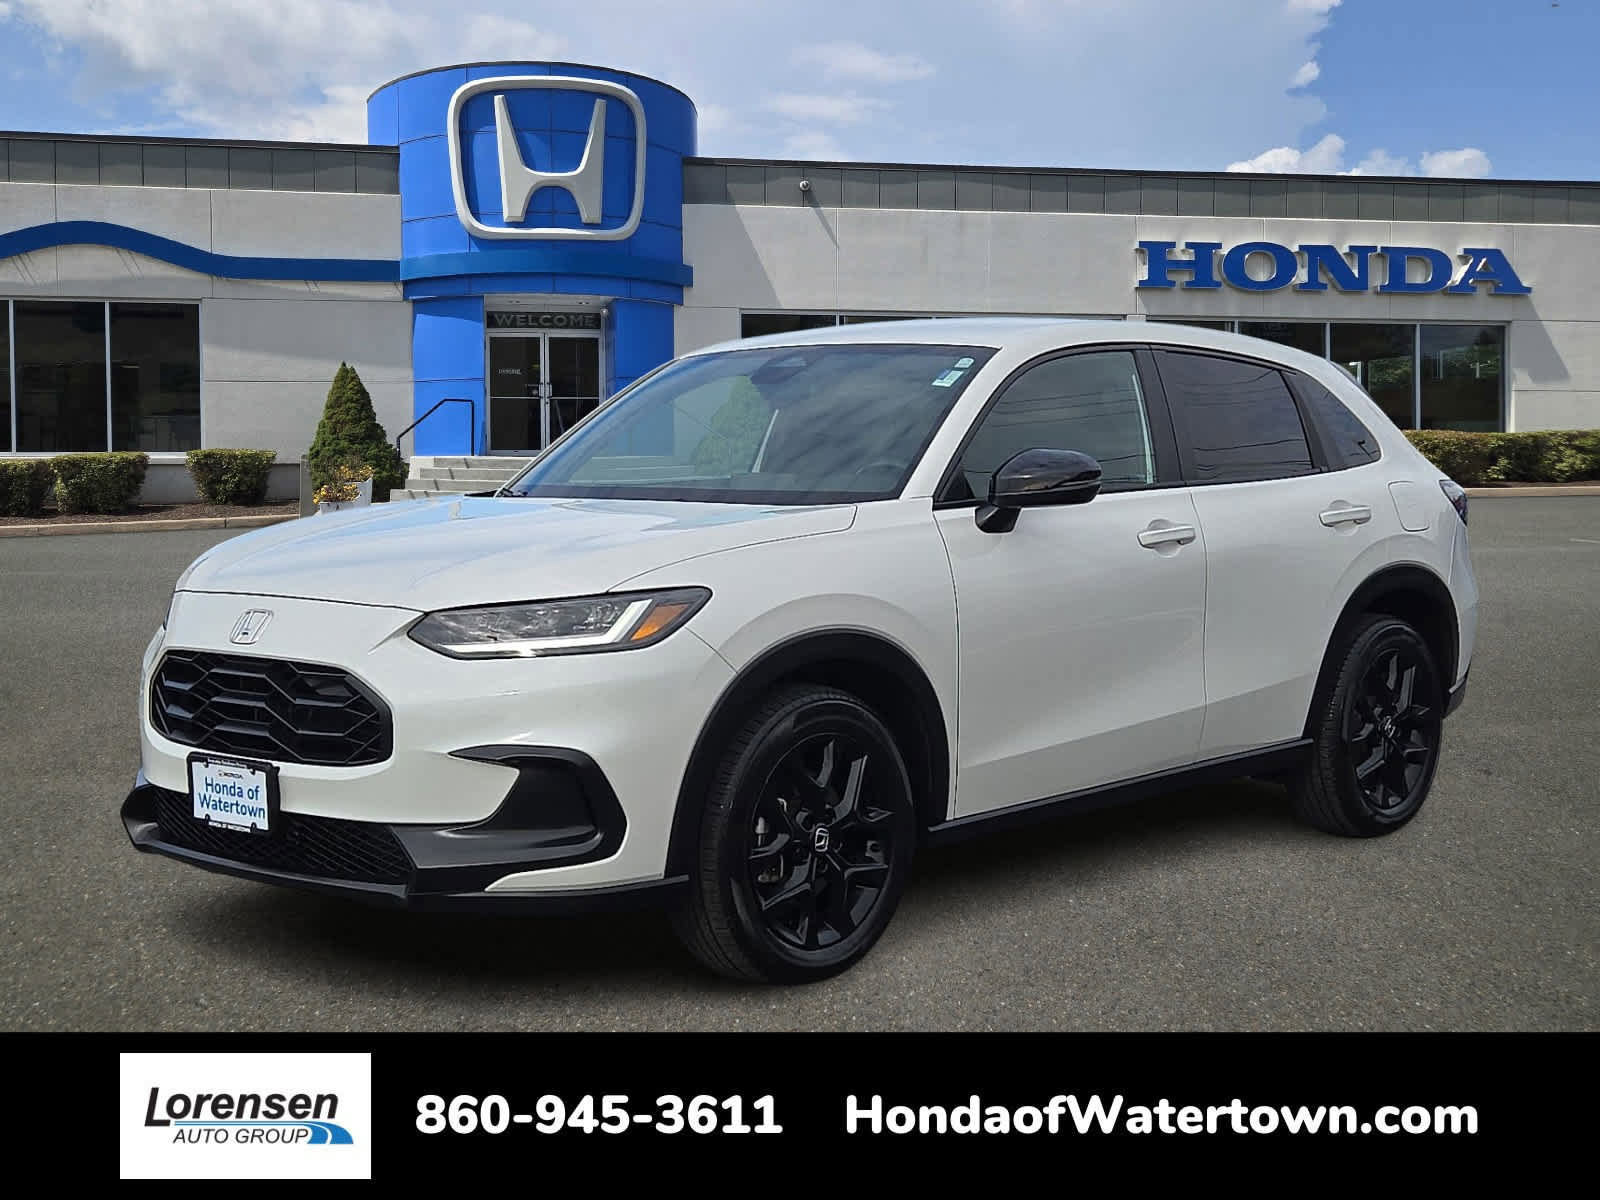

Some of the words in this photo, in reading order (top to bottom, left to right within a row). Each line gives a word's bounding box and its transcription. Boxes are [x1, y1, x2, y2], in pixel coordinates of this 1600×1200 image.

[1137, 241, 1532, 295] HONDA
[494, 314, 597, 328] WELCOME
[204, 776, 244, 798] Honda
[247, 785, 260, 801] of
[198, 792, 266, 820] Watertown
